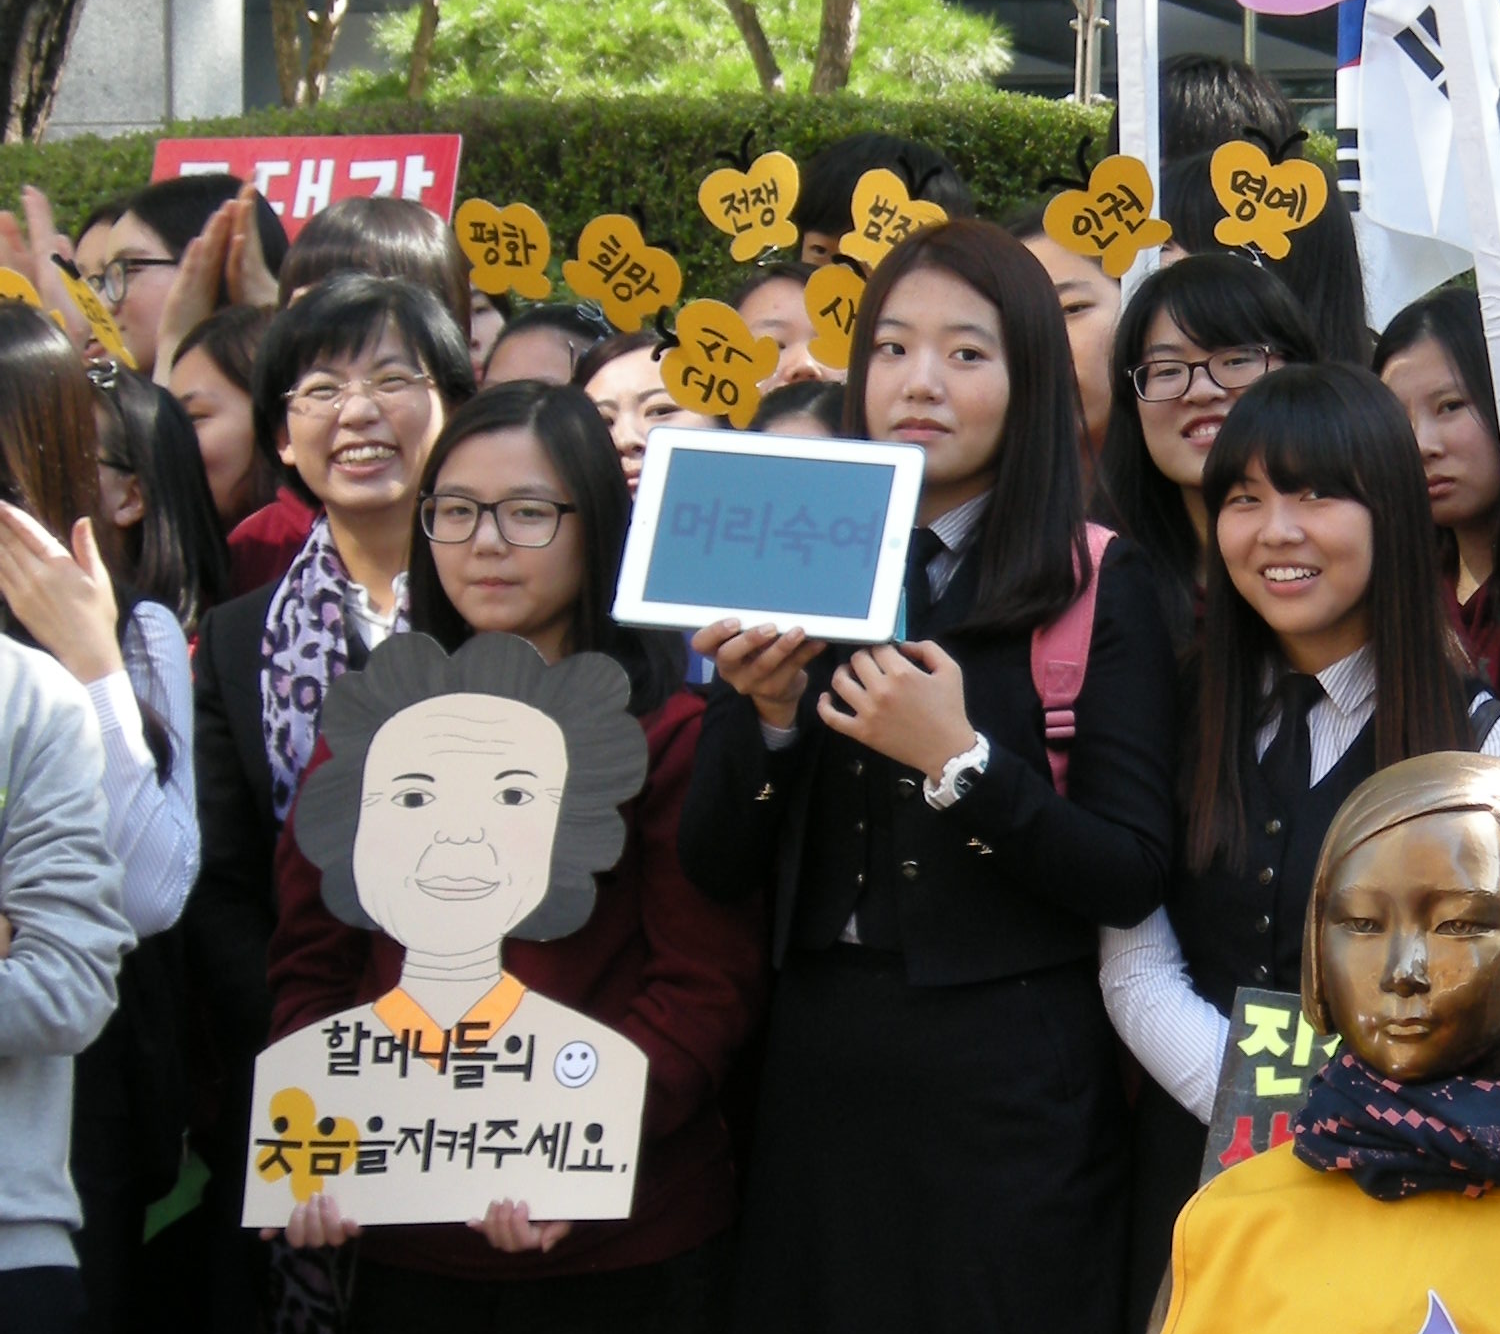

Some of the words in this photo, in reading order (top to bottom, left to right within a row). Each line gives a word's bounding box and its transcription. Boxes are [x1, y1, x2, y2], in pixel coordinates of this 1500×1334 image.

[720, 177, 779, 234] 전쟁
[1072, 184, 1147, 250] 인권
[1230, 170, 1308, 223] 명예
[470, 222, 537, 267] 평화
[588, 233, 660, 303] 희망
[669, 497, 880, 569] 머리숙여
[321, 1020, 536, 1089] 할머니들의
